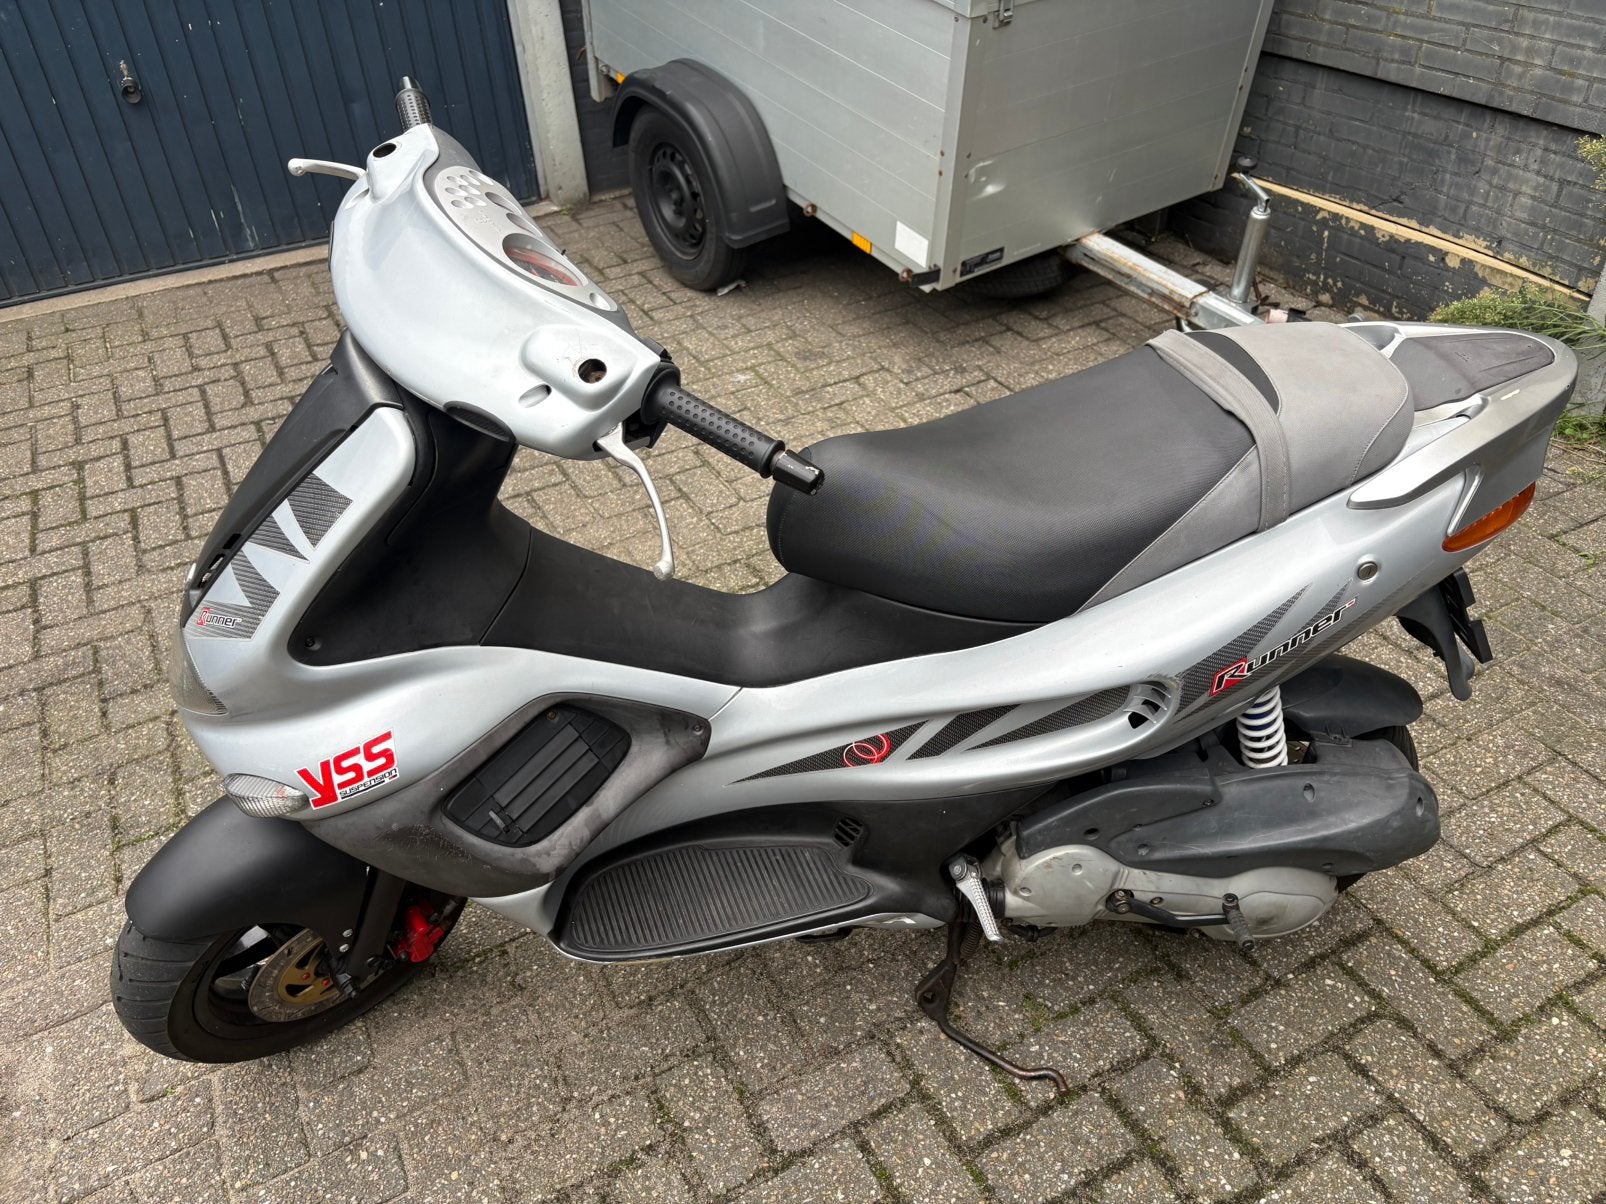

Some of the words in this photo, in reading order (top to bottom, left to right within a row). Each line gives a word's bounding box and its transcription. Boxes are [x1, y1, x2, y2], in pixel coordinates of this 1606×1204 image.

[197, 607, 238, 628] Runner
[1211, 603, 1350, 696] Runner
[296, 730, 395, 809] YSS
